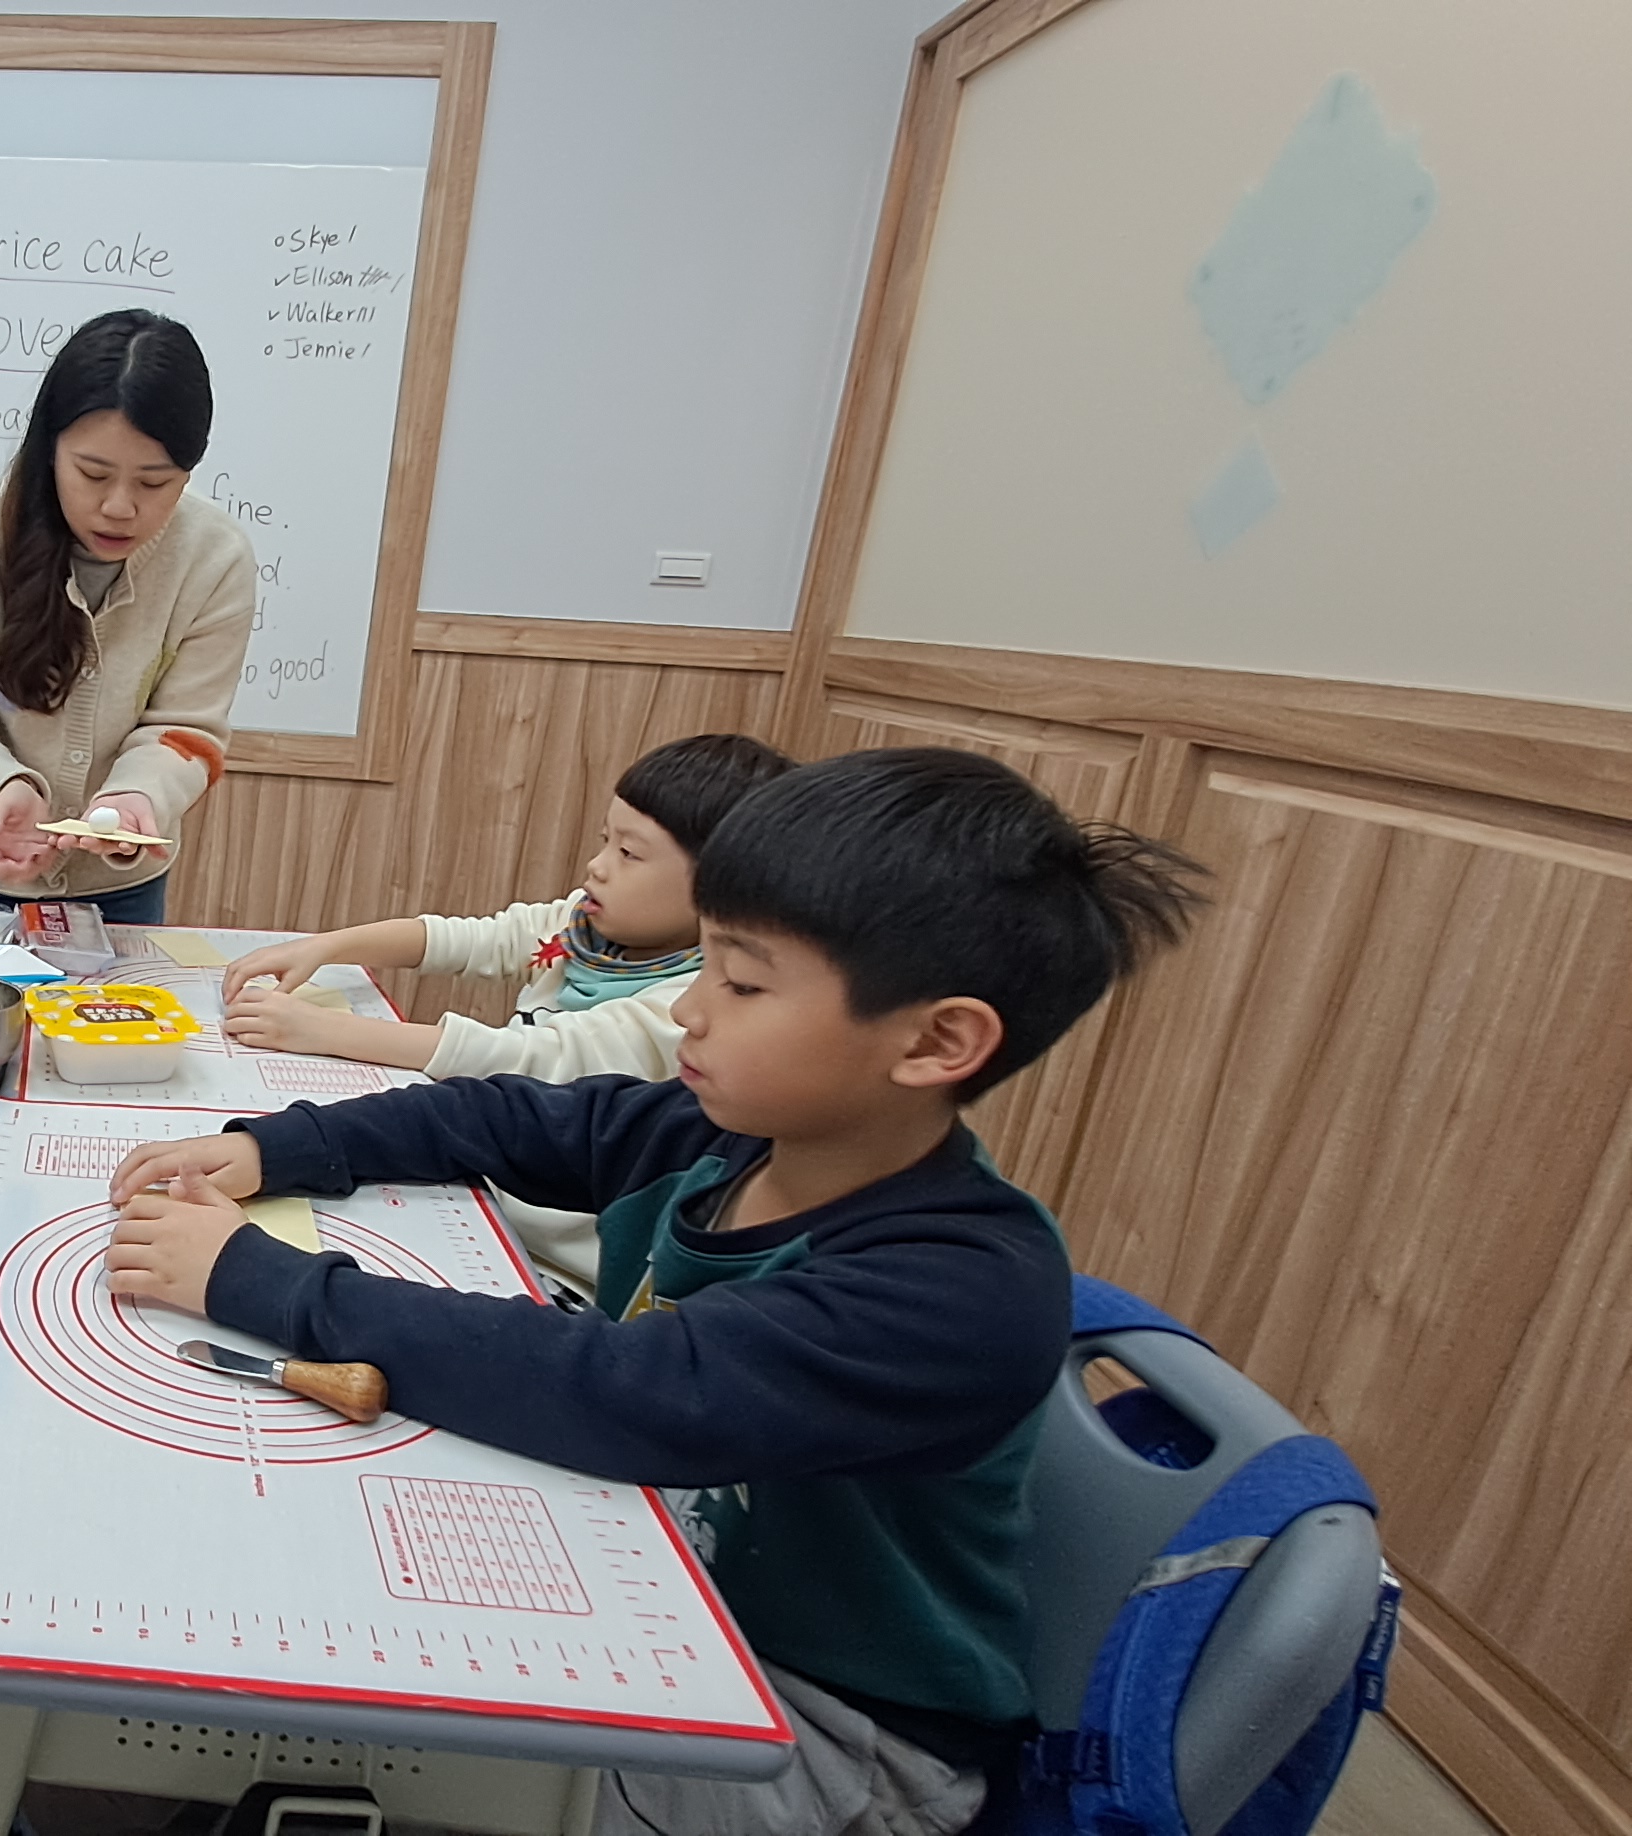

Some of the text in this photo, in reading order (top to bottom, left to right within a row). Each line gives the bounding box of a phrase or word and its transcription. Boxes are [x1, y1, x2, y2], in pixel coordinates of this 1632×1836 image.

[289, 224, 340, 255] Skye
[82, 231, 174, 278] cake
[293, 265, 354, 287] Ellison
[283, 337, 356, 360] Jennie
[138, 1628, 149, 1640] 10
[184, 1631, 196, 1643] 12
